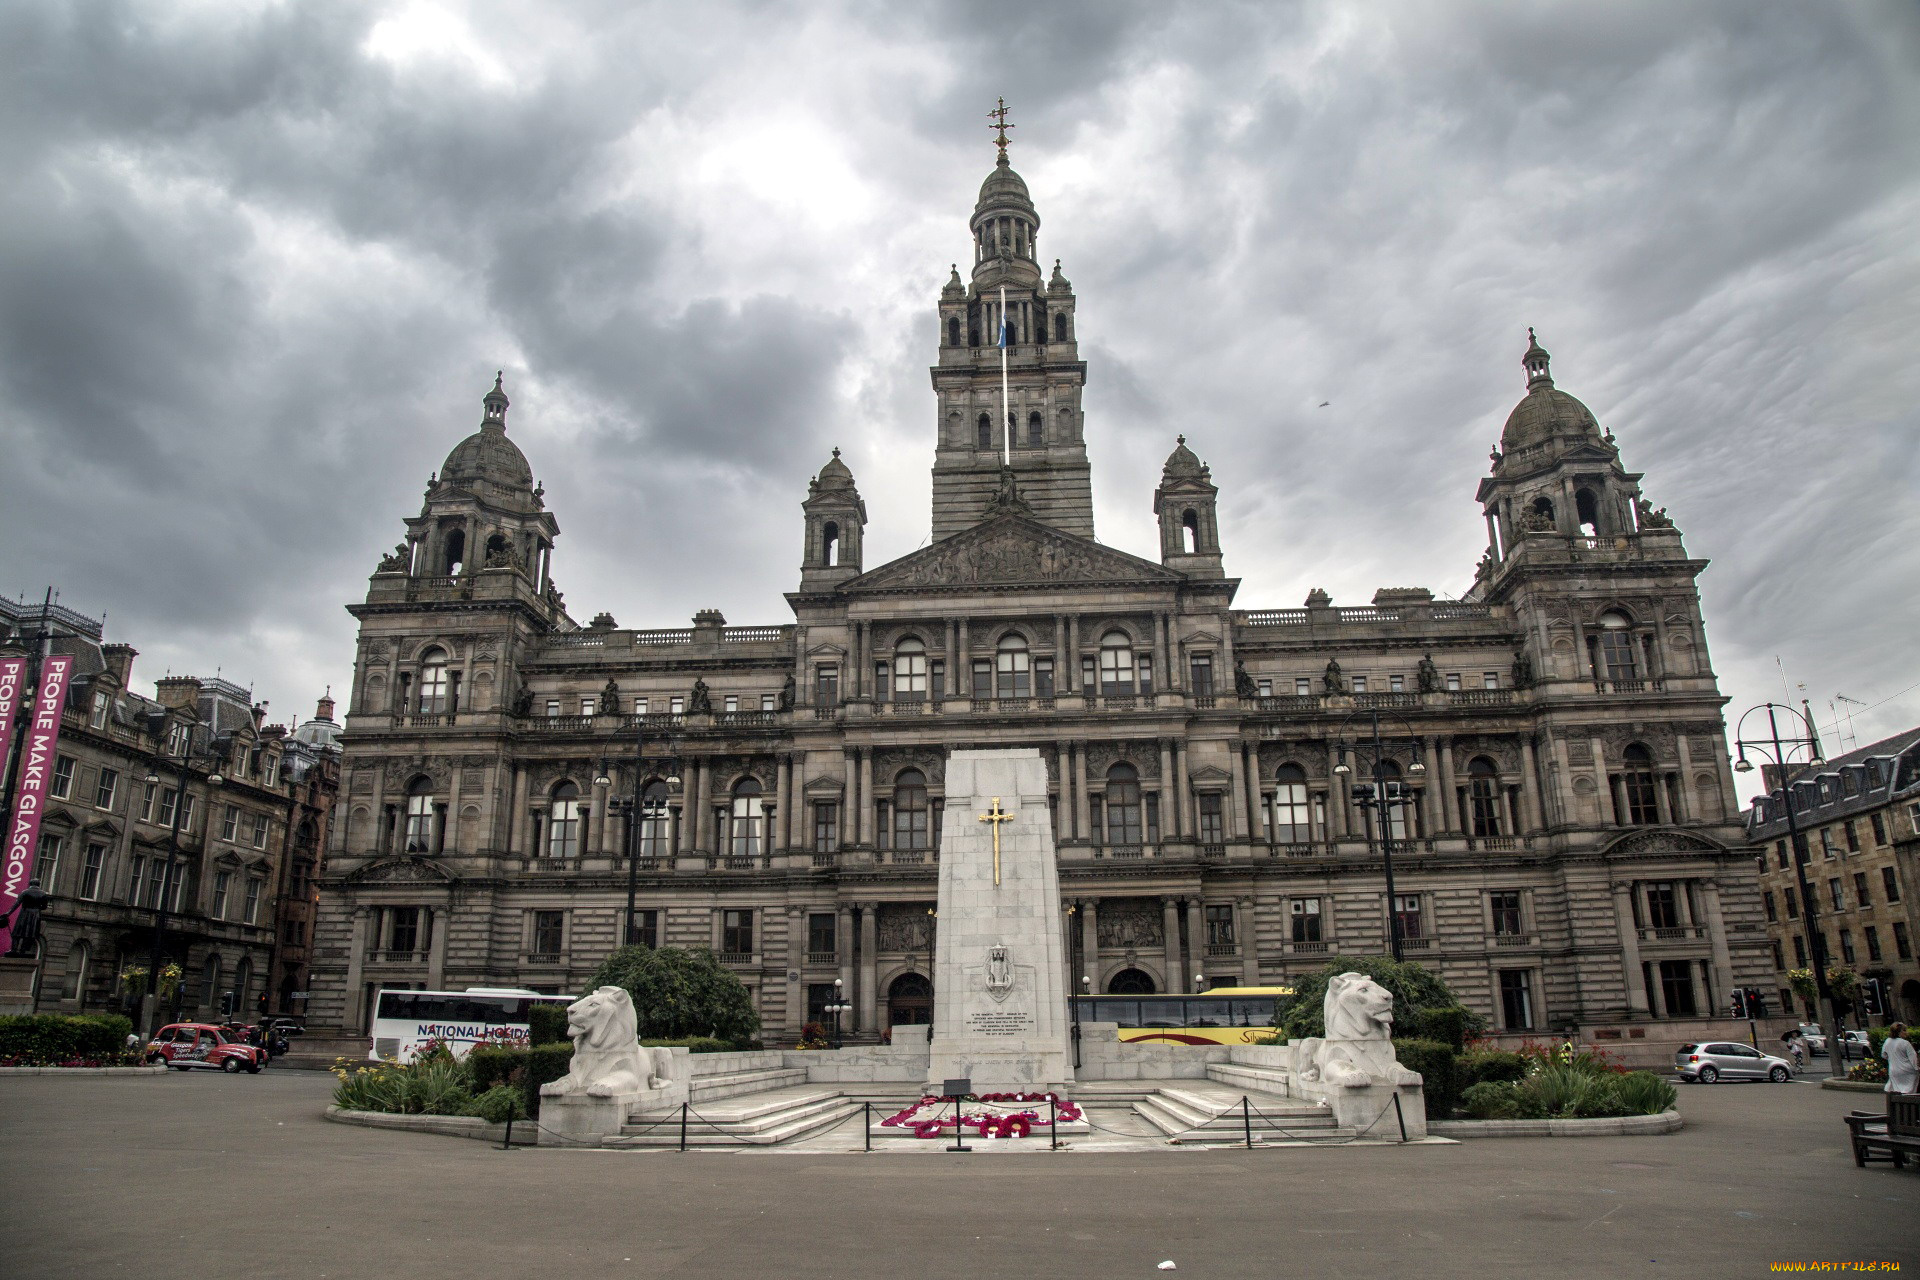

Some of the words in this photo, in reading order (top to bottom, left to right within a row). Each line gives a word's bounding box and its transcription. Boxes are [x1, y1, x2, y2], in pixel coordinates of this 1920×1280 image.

[36, 661, 66, 729] PEOPLE
[23, 734, 50, 791] MAKE
[3, 794, 37, 898] GLASGOW
[417, 1024, 480, 1038] NATIONAL
